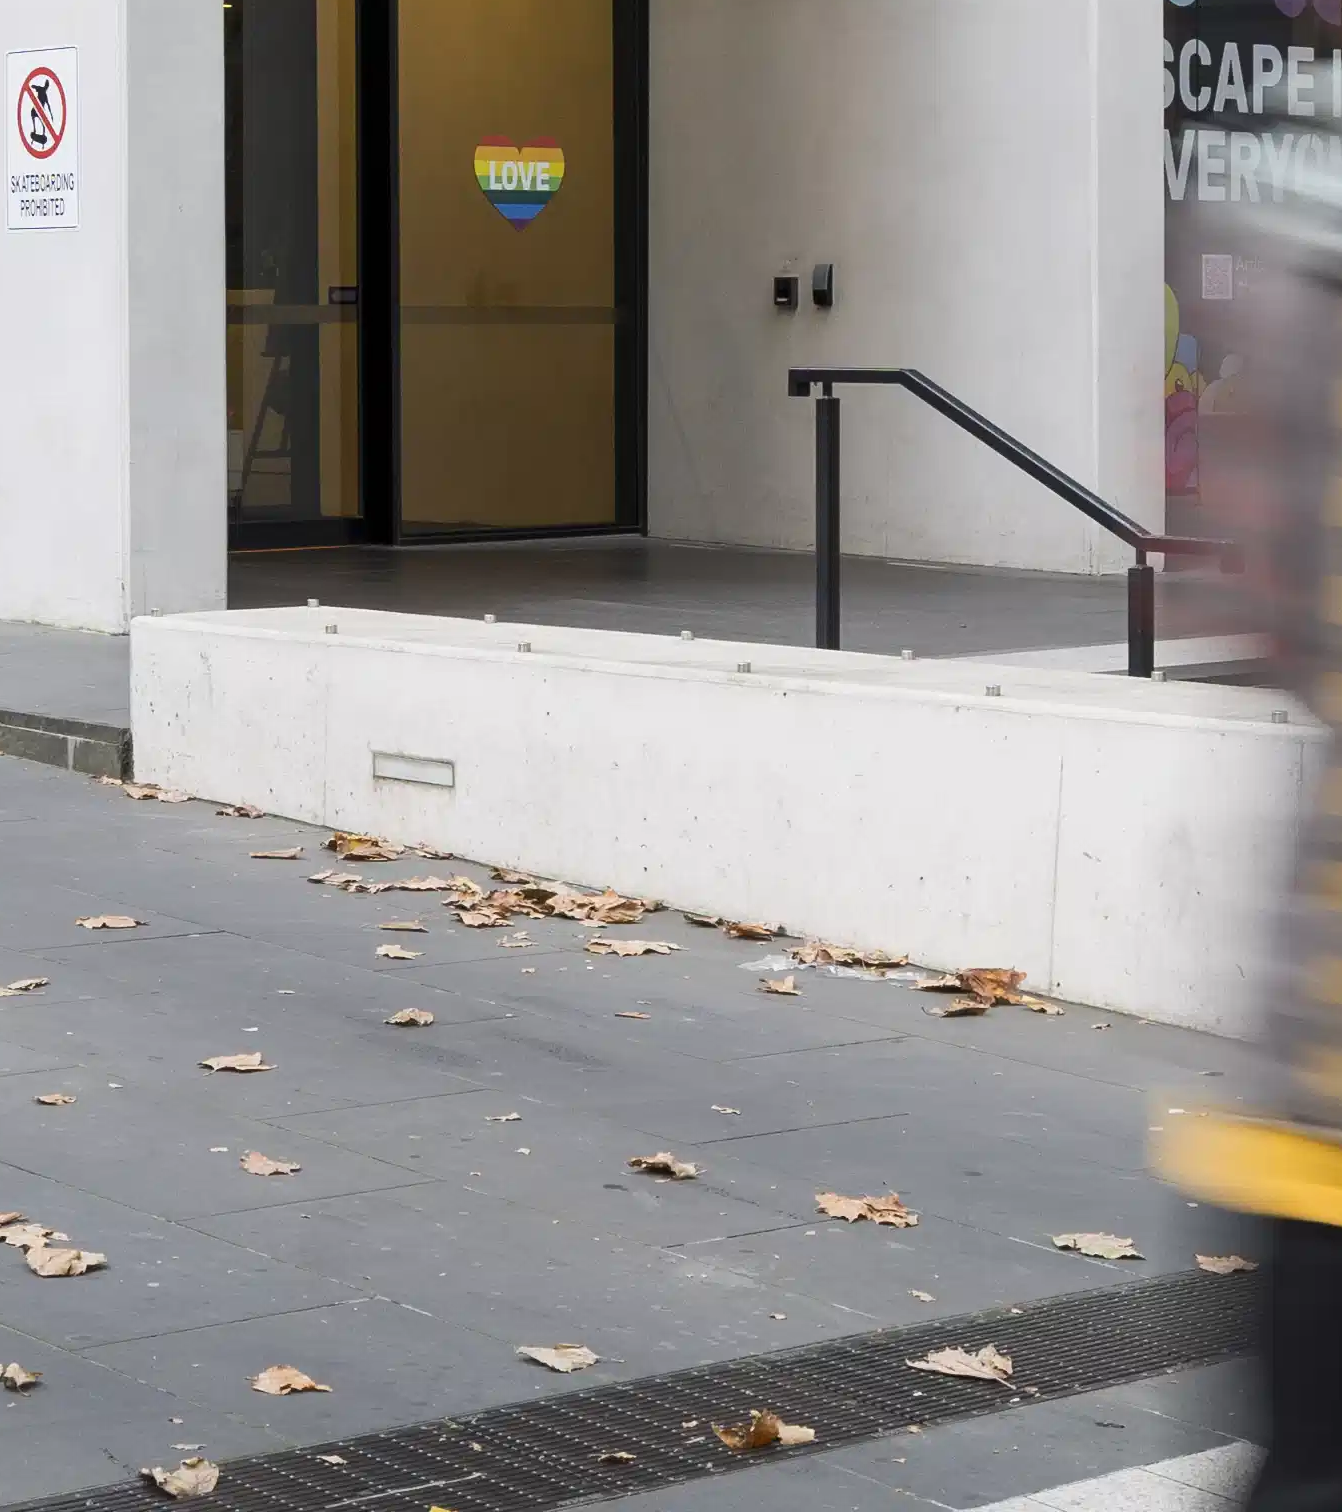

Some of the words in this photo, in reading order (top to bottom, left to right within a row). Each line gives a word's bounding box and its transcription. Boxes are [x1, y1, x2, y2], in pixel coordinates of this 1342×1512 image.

[10, 173, 74, 193] SKATEBOARDING
[488, 160, 550, 191] LOVE
[20, 197, 65, 217] PROHIBITED
